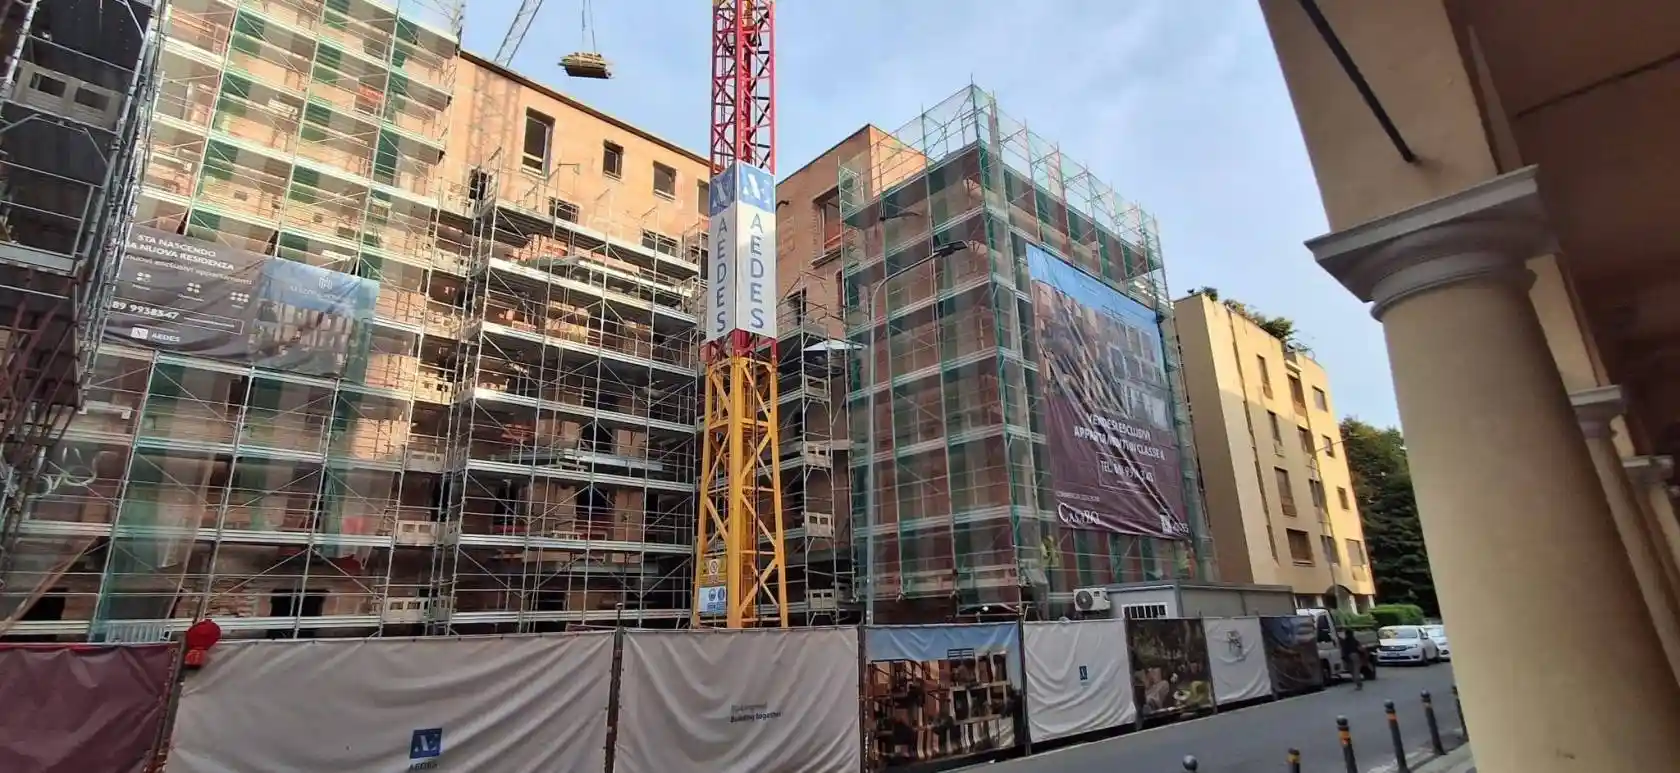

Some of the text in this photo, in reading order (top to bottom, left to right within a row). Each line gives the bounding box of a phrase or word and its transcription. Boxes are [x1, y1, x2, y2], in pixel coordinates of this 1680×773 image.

[137, 233, 217, 258] STA NASCENDO
[139, 243, 178, 258] NUOVA
[179, 252, 235, 271] RESIDENZA
[716, 216, 728, 332] AEDES
[750, 212, 764, 329] AEDES
[151, 331, 181, 343] AEDES
